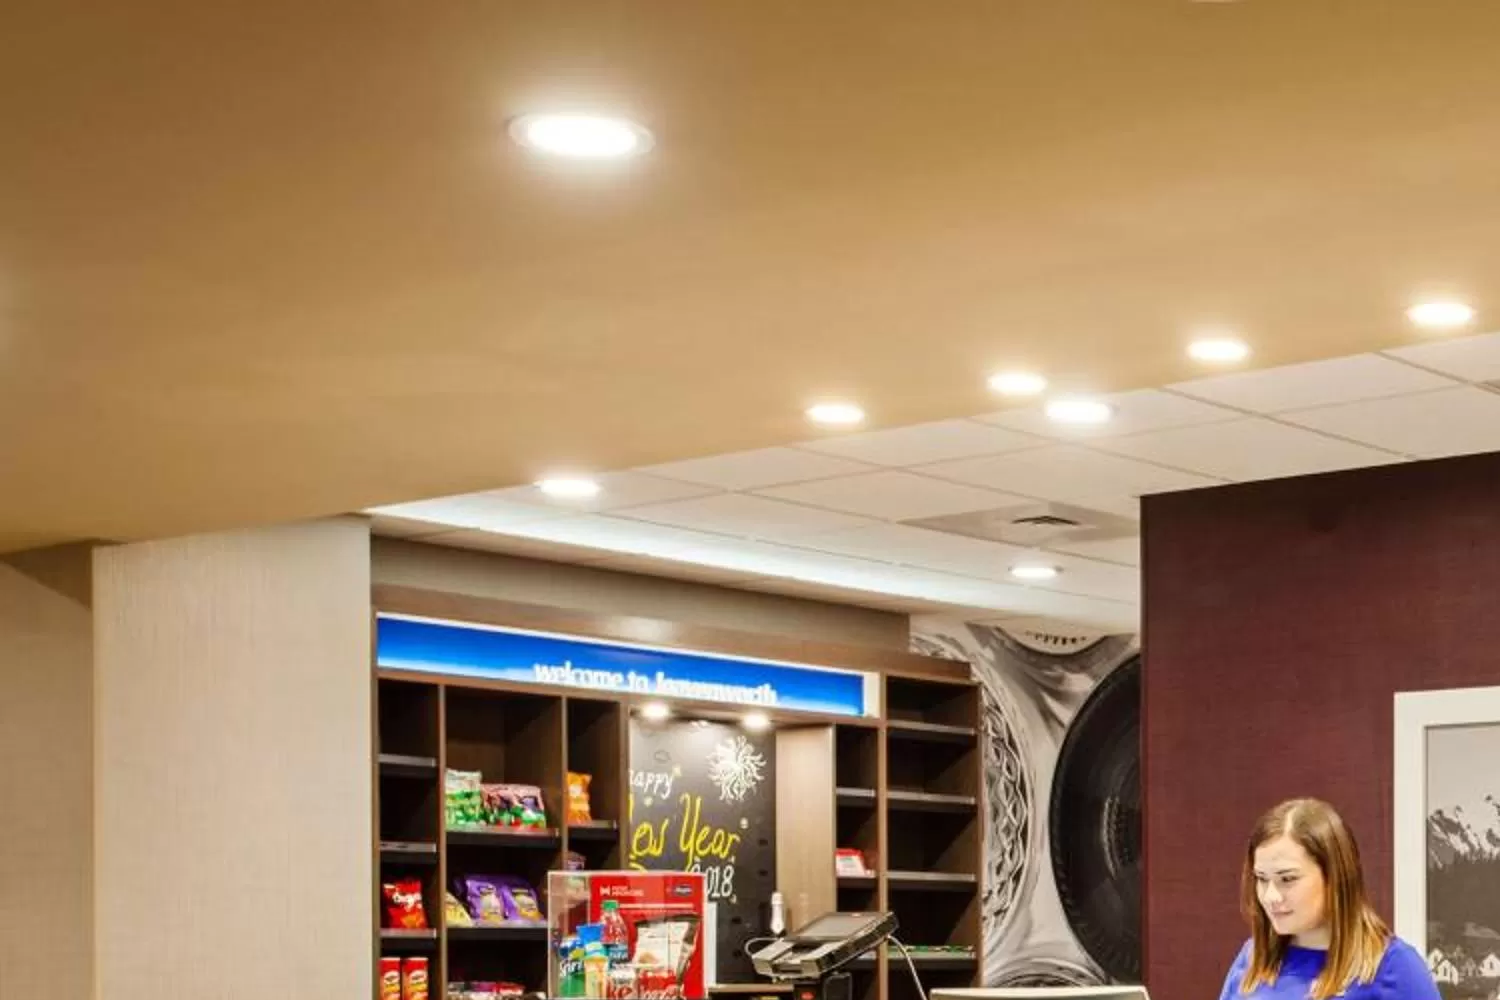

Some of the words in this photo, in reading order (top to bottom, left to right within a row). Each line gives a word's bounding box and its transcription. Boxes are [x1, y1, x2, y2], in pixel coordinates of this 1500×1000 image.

[533, 660, 624, 687] welcome
[628, 669, 649, 692] to
[630, 769, 674, 799] appy
[630, 792, 669, 857] ew
[680, 792, 741, 873] Year
